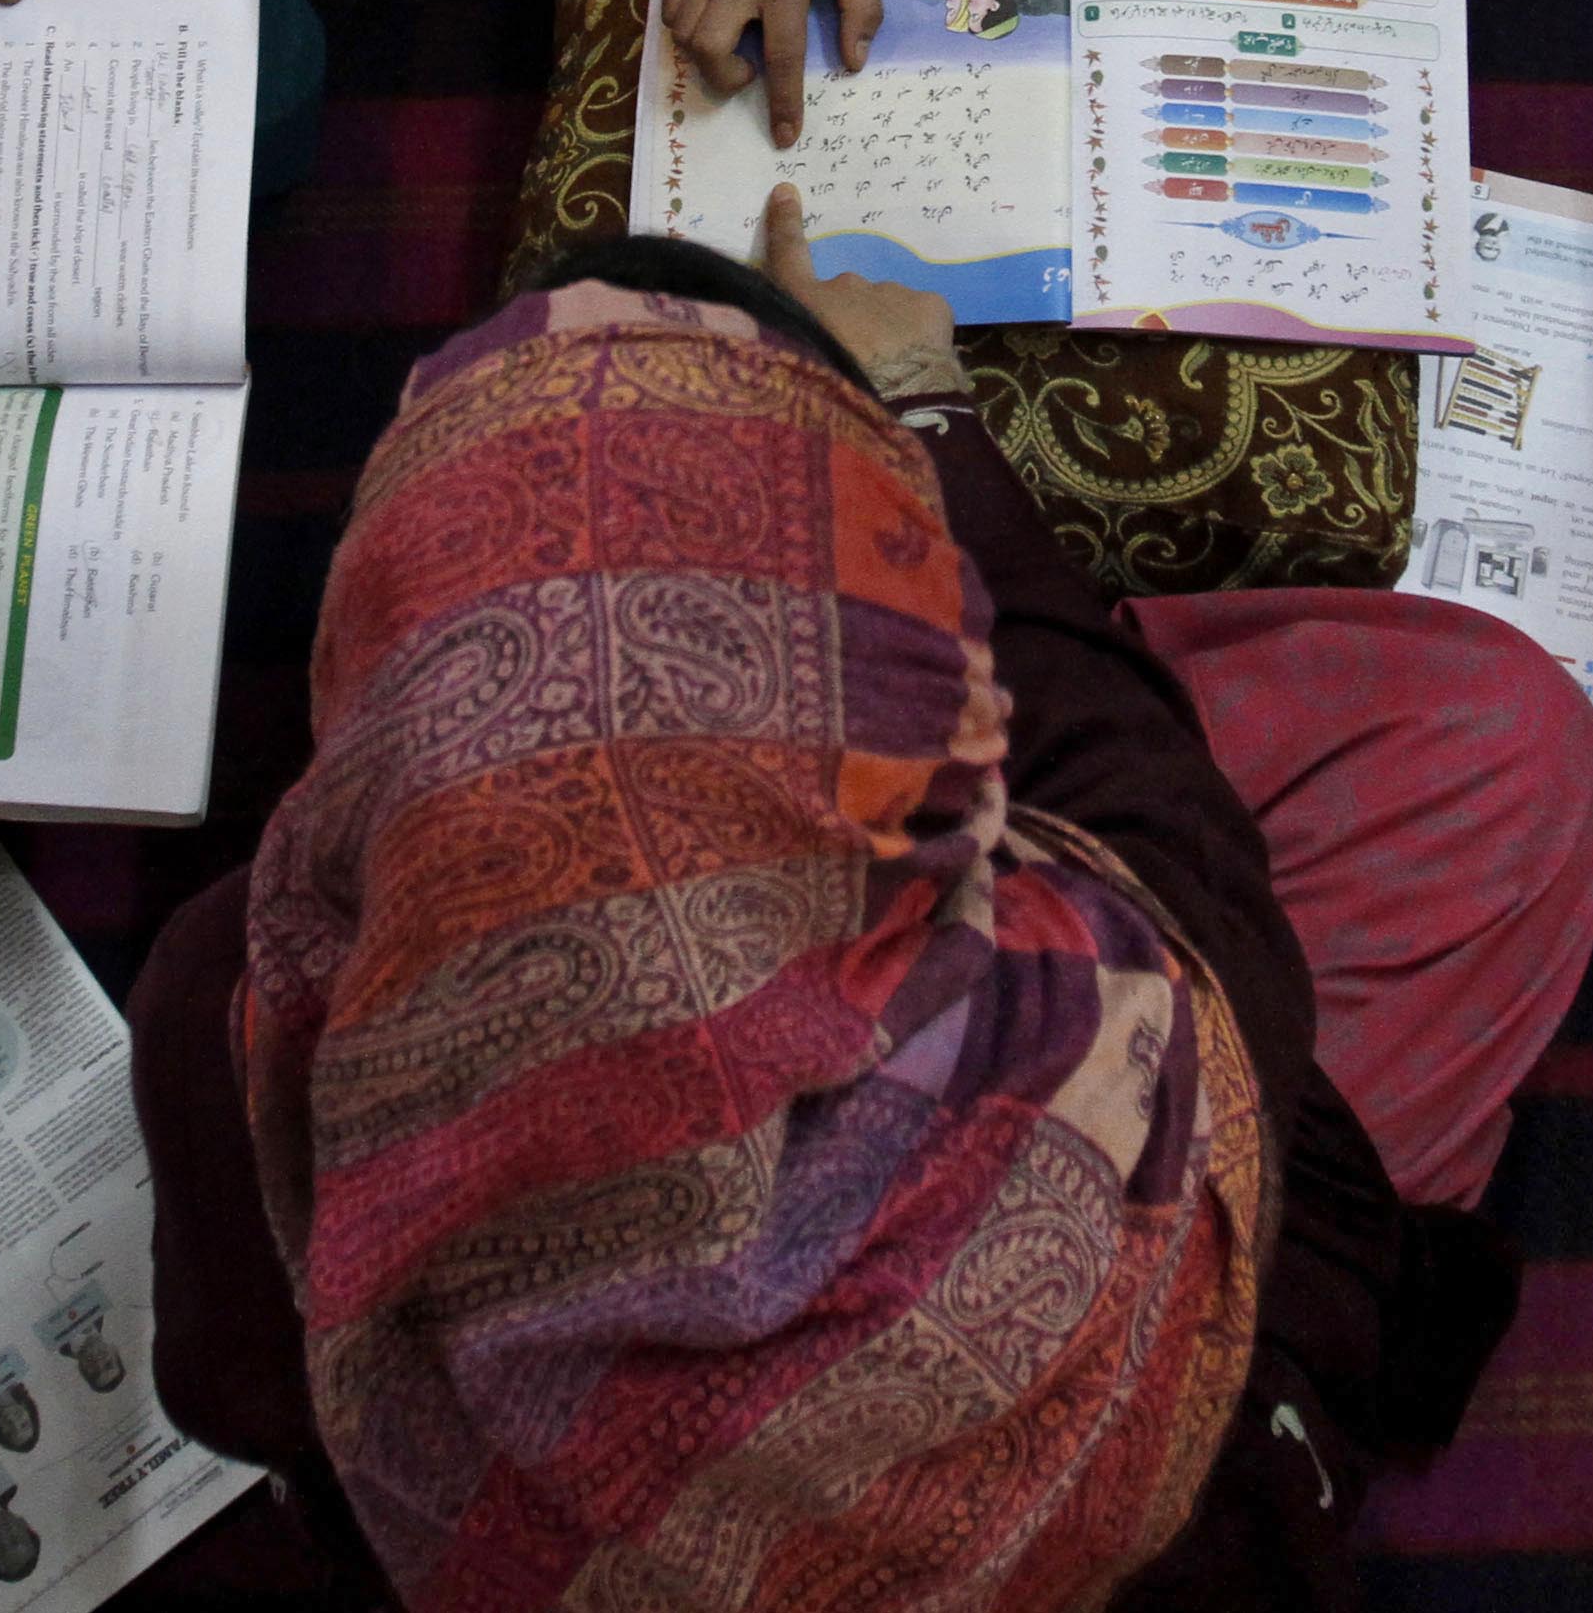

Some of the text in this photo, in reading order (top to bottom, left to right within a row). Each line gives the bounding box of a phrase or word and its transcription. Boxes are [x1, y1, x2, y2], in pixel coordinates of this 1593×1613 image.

[45, 25, 55, 36] C.
[43, 41, 54, 66] Read
[42, 68, 52, 81] the
[172, 24, 188, 127] B. Fill in the blanks.
[126, 58, 140, 125] People living in
[37, 83, 51, 128] following
[35, 130, 48, 182] statements
[33, 184, 44, 202] and
[32, 204, 42, 226] then
[50, 199, 63, 253] surrounded
[70, 172, 86, 284] is called the ship of desert.
[47, 254, 58, 267] by
[27, 263, 36, 282] true
[49, 268, 58, 282] the
[26, 285, 36, 304] and
[48, 284, 56, 300] sea
[25, 306, 34, 333] cross
[46, 302, 56, 324] from
[24, 335, 34, 348] (x)
[46, 326, 56, 337] all
[25, 350, 34, 365] the
[45, 339, 56, 364] sides.
[15, 503, 38, 605] GREEN PLANET
[96, 1432, 190, 1510] FAMILY TREE
